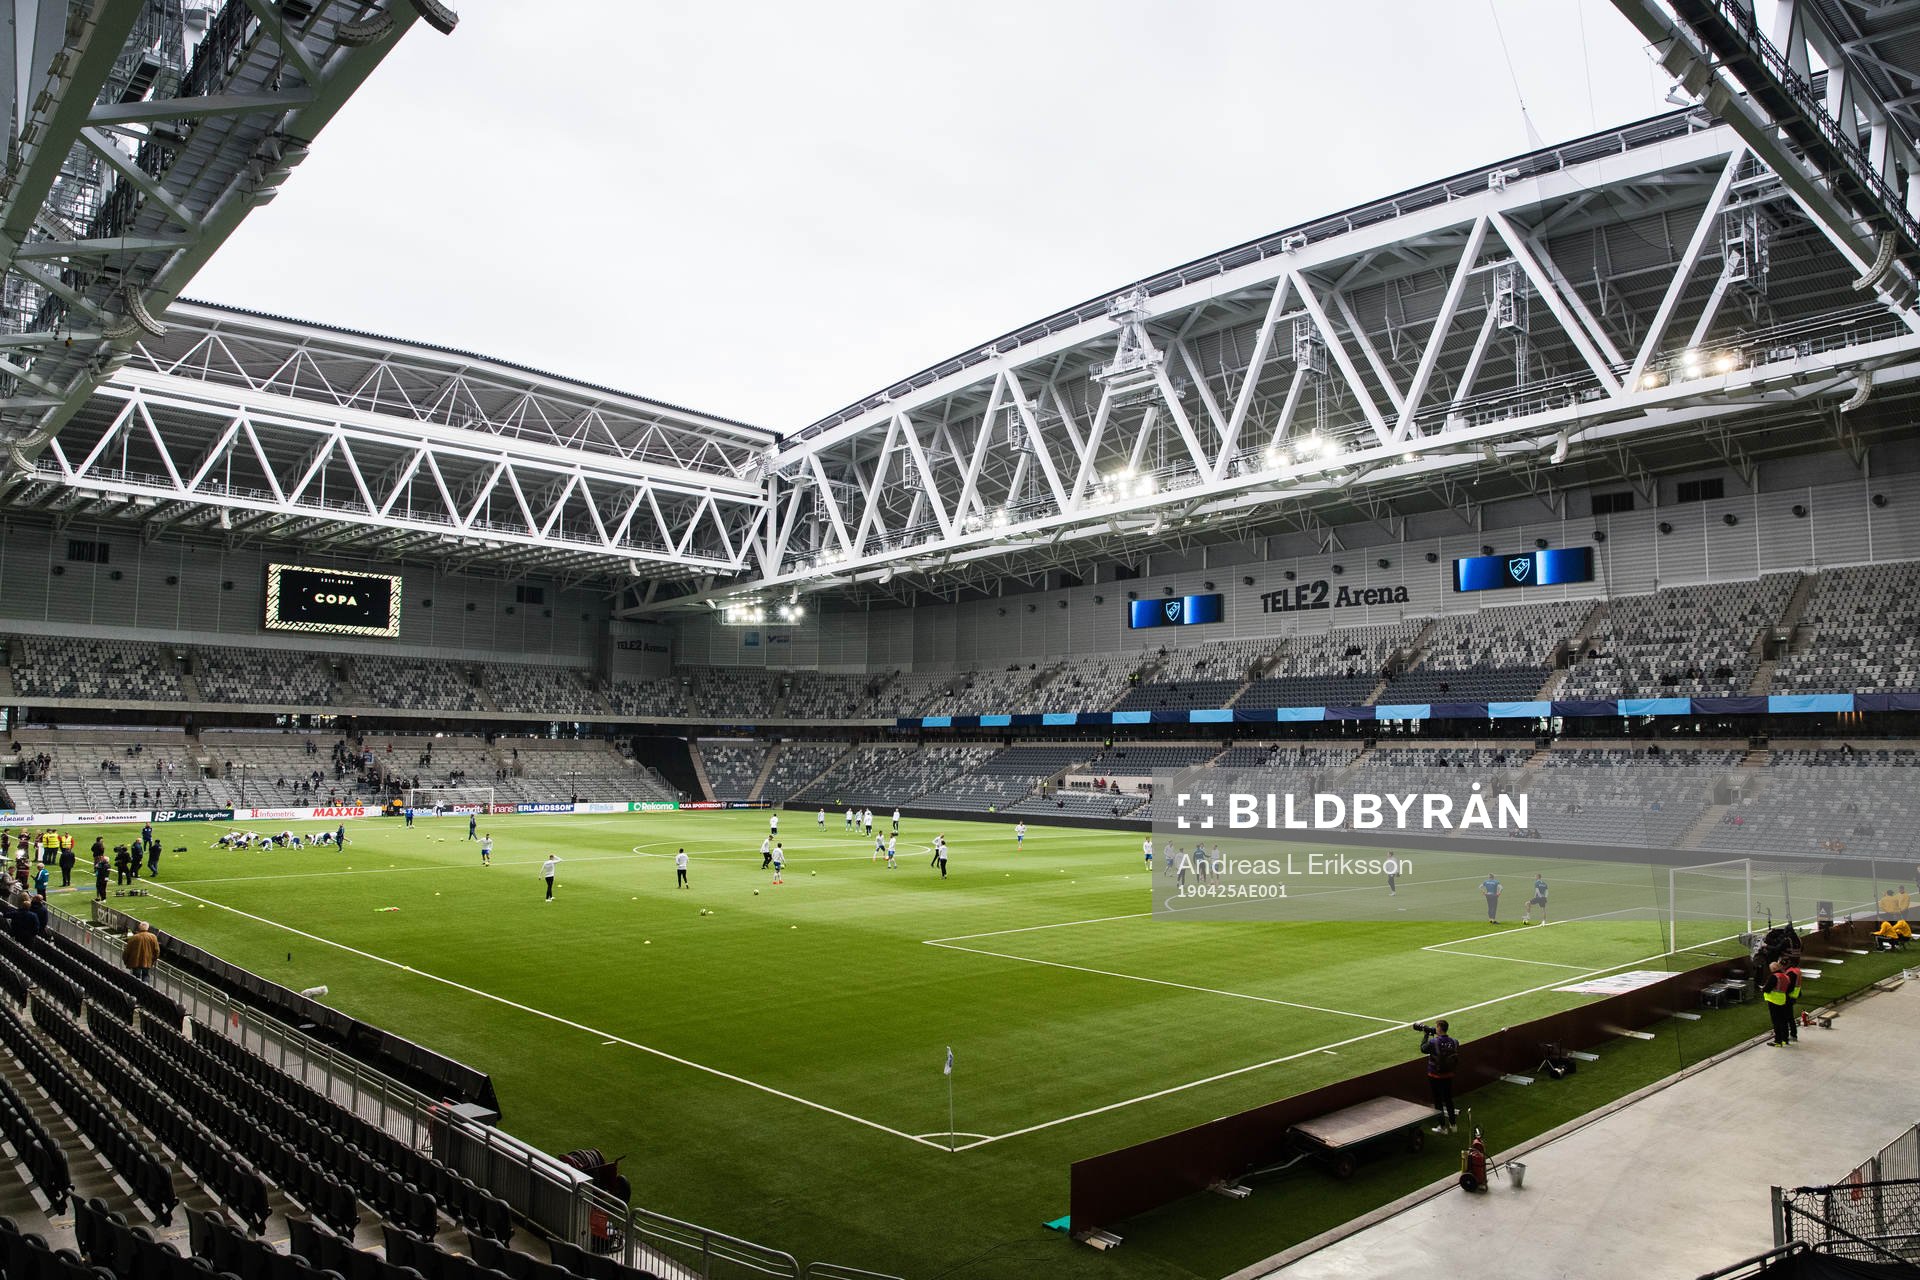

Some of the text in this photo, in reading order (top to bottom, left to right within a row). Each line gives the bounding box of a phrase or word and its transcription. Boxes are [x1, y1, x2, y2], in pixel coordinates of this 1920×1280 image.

[314, 593, 358, 606] COPA
[1260, 580, 1410, 613] TELE2 Arena
[616, 640, 642, 650] TELE2
[518, 804, 570, 812] ERLANDSSON
[641, 802, 674, 811] Rekomo
[154, 811, 176, 822] ISP
[205, 812, 230, 821] together
[260, 809, 295, 818] Infometric
[312, 807, 365, 817] MAXXIS
